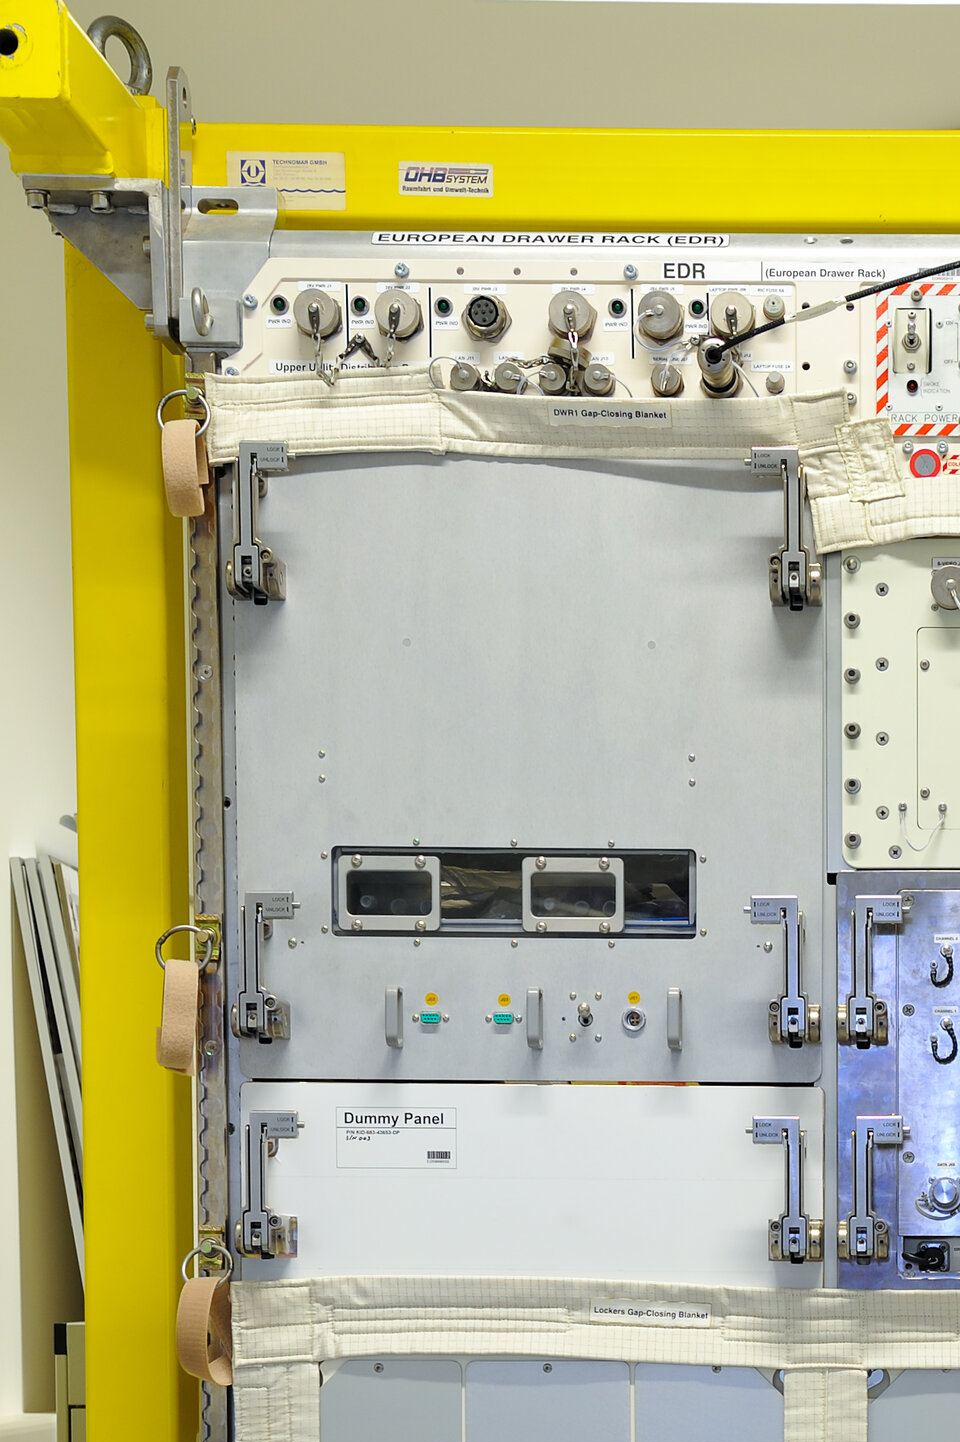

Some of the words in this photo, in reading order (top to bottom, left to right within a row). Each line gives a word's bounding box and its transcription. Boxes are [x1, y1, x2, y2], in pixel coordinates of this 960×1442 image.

[404, 166, 448, 183] OHB
[446, 174, 488, 184] SYSTEM
[445, 186, 489, 194] Umwelt-Technik
[377, 233, 495, 244] EUROPEAN
[502, 234, 594, 244] DRAWER
[601, 235, 660, 245] RACK
[667, 235, 725, 247] (EDR)
[663, 263, 706, 279] EDR
[765, 268, 817, 279] (European
[819, 268, 855, 278] Drawer
[858, 268, 886, 279] Rack)
[275, 362, 306, 372] Upper
[553, 408, 578, 417] DWR1
[580, 409, 633, 420] Gap-Closing
[635, 410, 667, 419] Blanket
[891, 414, 918, 422] RACK
[924, 414, 959, 422] POWER
[344, 1112, 399, 1127] Dummy
[404, 1112, 445, 1125] Panel
[593, 1306, 625, 1315] Lockers
[627, 1308, 676, 1320] Gap-Closing
[678, 1311, 708, 1319] Blanket
